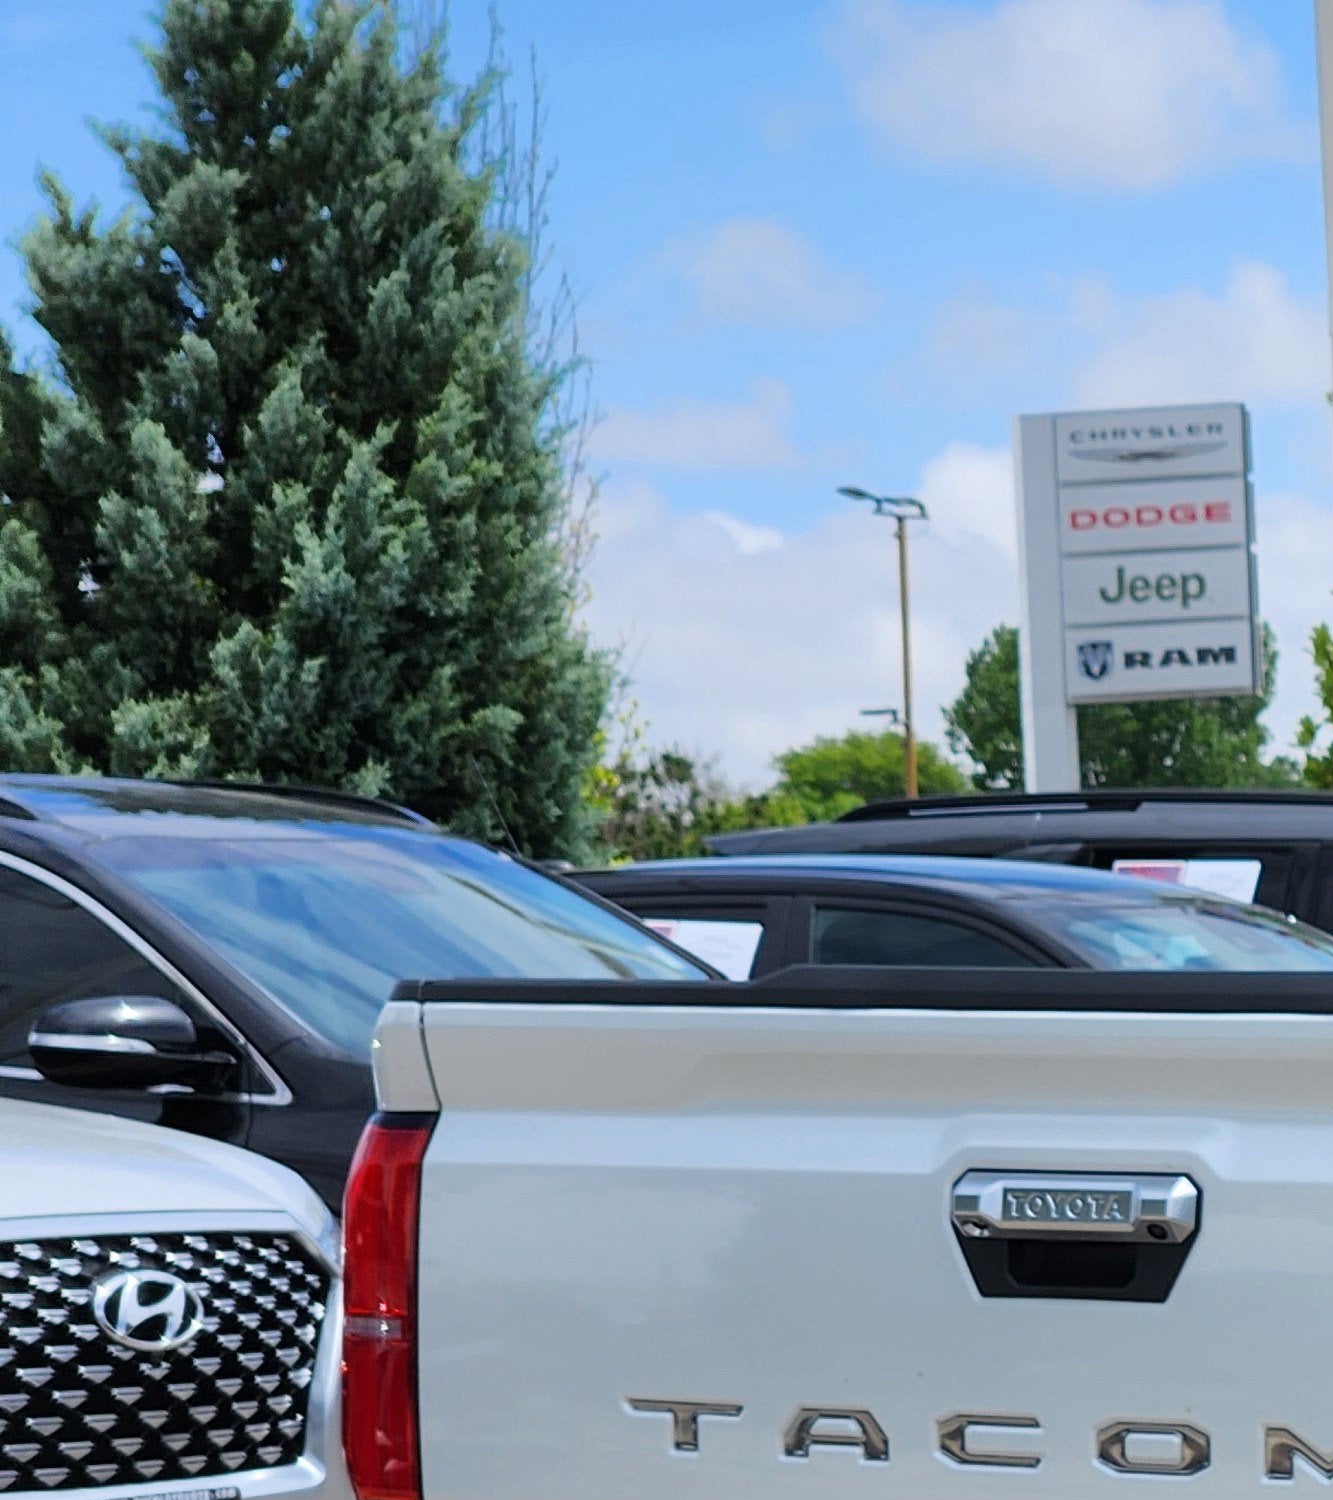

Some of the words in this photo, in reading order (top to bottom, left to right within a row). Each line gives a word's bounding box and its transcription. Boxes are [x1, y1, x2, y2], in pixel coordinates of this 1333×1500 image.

[1068, 422, 1223, 444] CHRYSLER
[1069, 501, 1232, 531] DODGE
[1098, 565, 1207, 609] Jeep
[1123, 646, 1238, 669] RAM
[1007, 1190, 1124, 1221] TOYOTA
